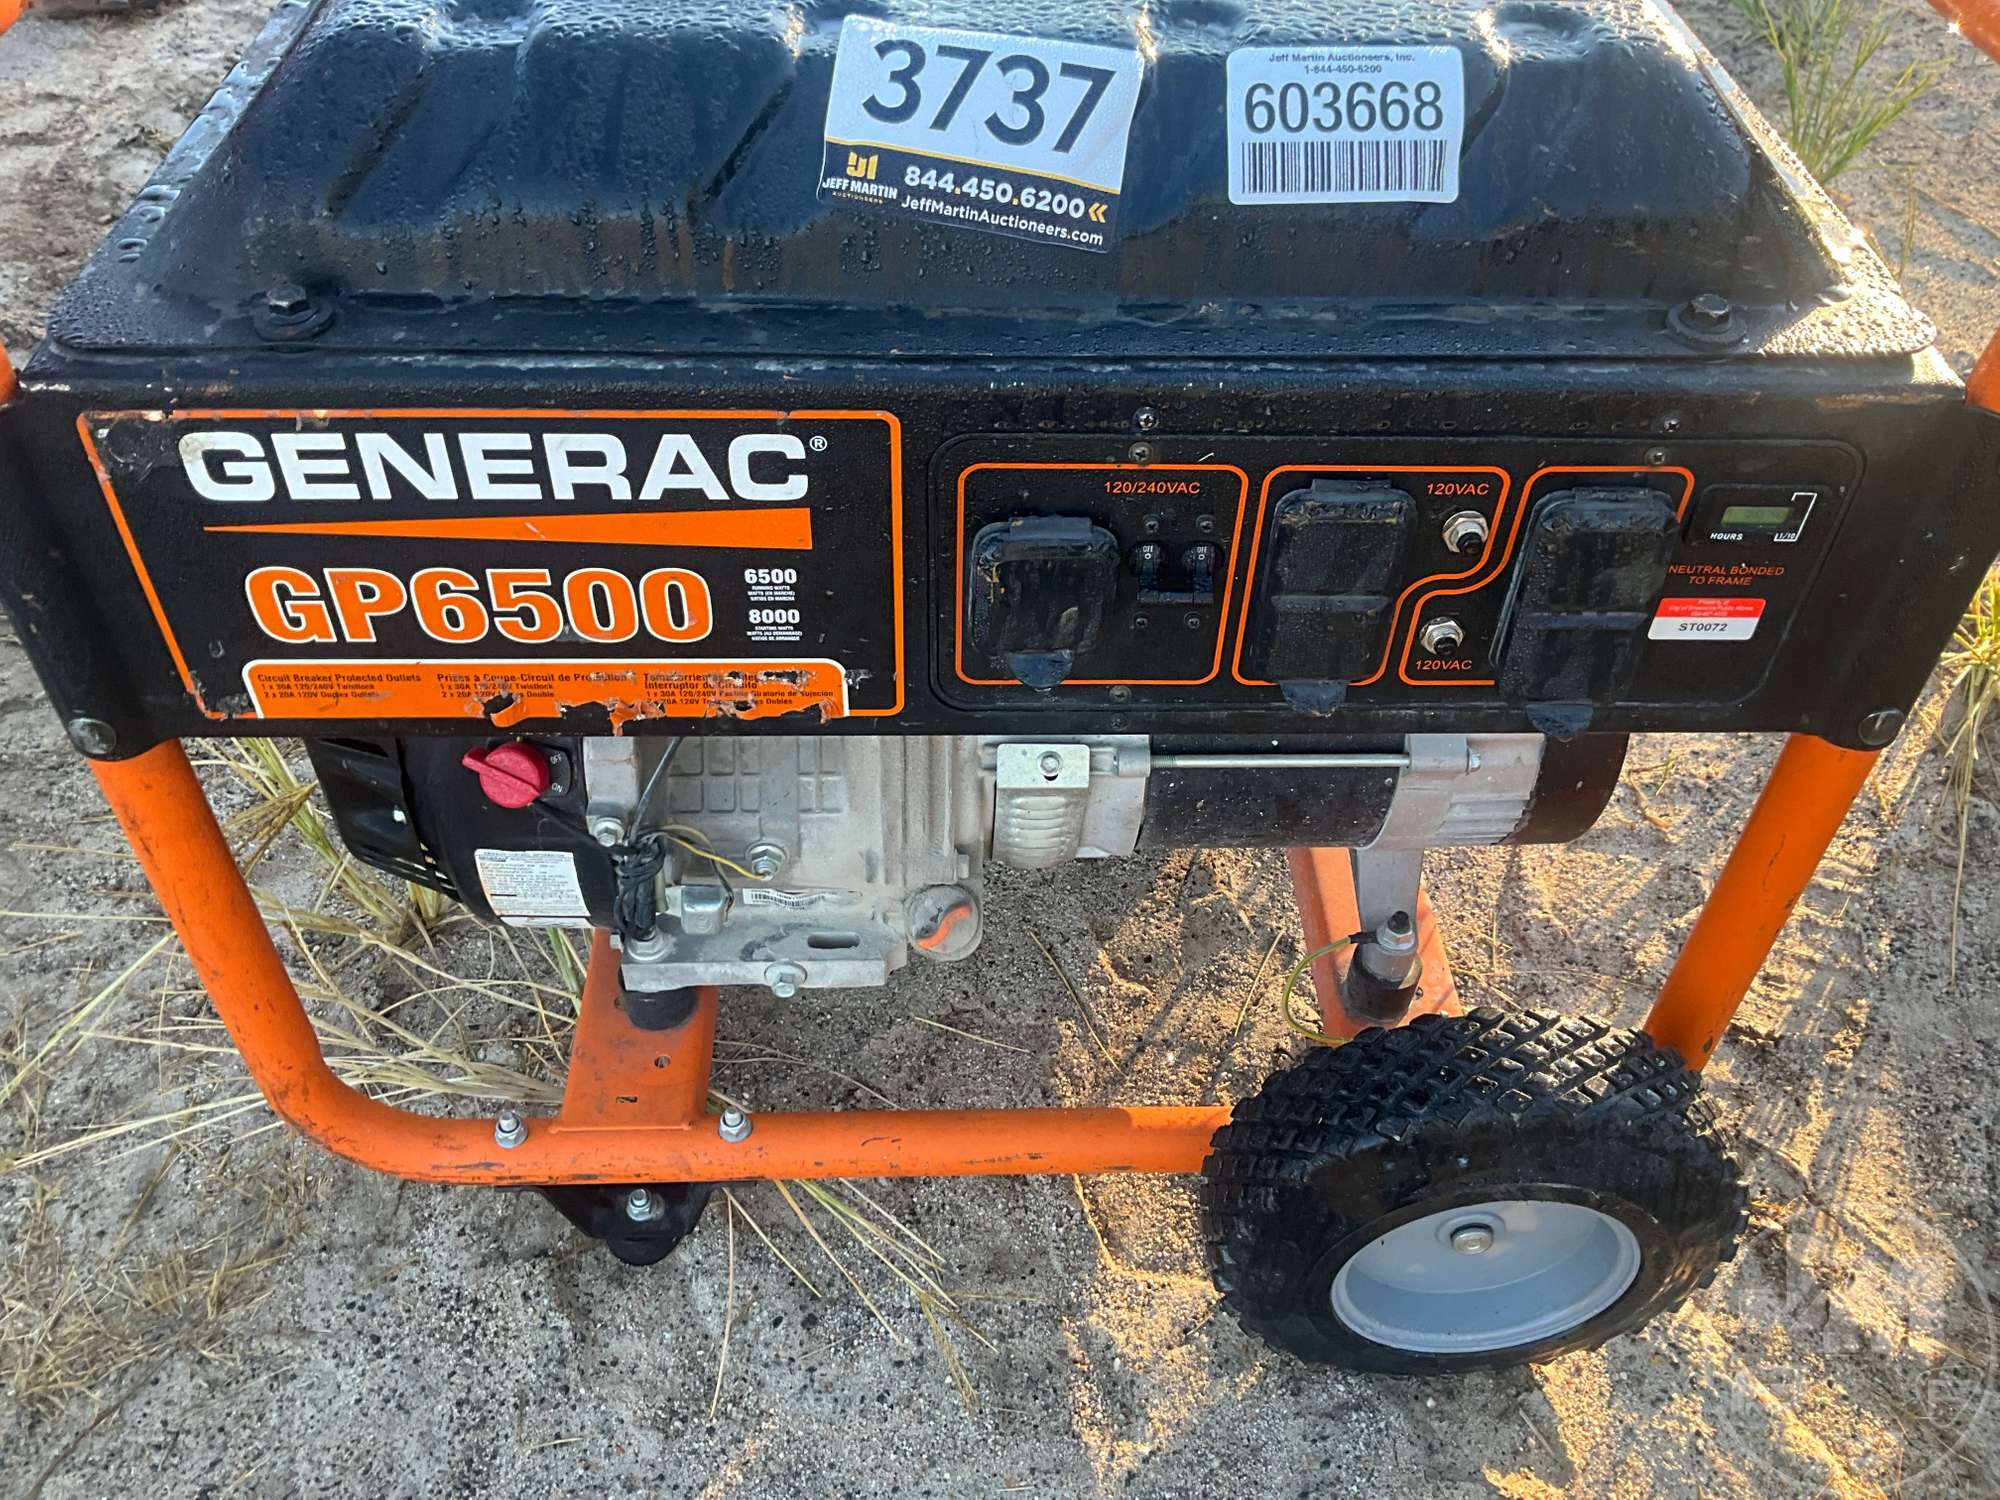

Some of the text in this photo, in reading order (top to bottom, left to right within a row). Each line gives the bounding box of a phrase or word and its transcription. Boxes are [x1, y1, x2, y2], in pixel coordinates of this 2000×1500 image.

[1269, 53, 1415, 63] Jeff Martin Auctioneers, Inc.
[862, 39, 1116, 154] 3737
[1245, 81, 1443, 133] 603668
[822, 177, 898, 199] JEFF MARTIN
[904, 166, 1085, 219] 844.450.6200
[901, 195, 1104, 246] JeffMartinAuctioneers.com
[1104, 481, 1201, 494] 120/240VAC
[1427, 482, 1490, 496] 120VAC
[1709, 532, 1744, 541] HOURS
[744, 568, 798, 584] 6500
[1668, 565, 1785, 576] NEUTRAL BONDED
[1688, 576, 1752, 586] TO FRAME
[244, 565, 714, 645] GP6500
[748, 609, 800, 624] 8000
[1678, 622, 1729, 632] ST0072
[1415, 659, 1473, 671] 120VAC
[257, 673, 421, 682] Circuit Breaker Protected Outlets
[558, 673, 571, 682] de
[645, 681, 698, 691] Interruptor
[552, 782, 563, 793] ON
